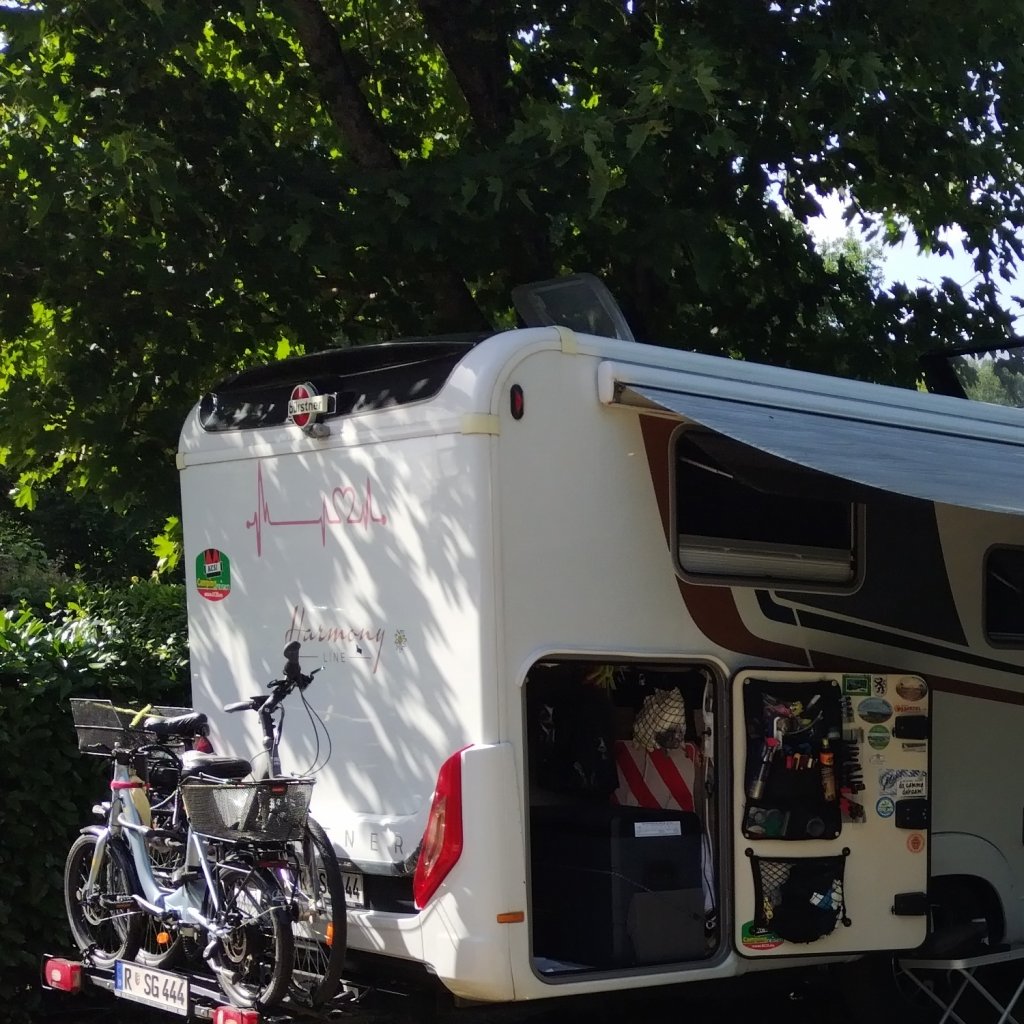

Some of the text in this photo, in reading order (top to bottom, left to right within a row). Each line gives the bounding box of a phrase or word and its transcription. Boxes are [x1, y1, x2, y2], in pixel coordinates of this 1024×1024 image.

[284, 604, 386, 674] Harmony
[322, 652, 346, 663] LINE
[124, 967, 132, 991] R
[143, 973, 160, 998] SG
[162, 978, 185, 1005] 444
